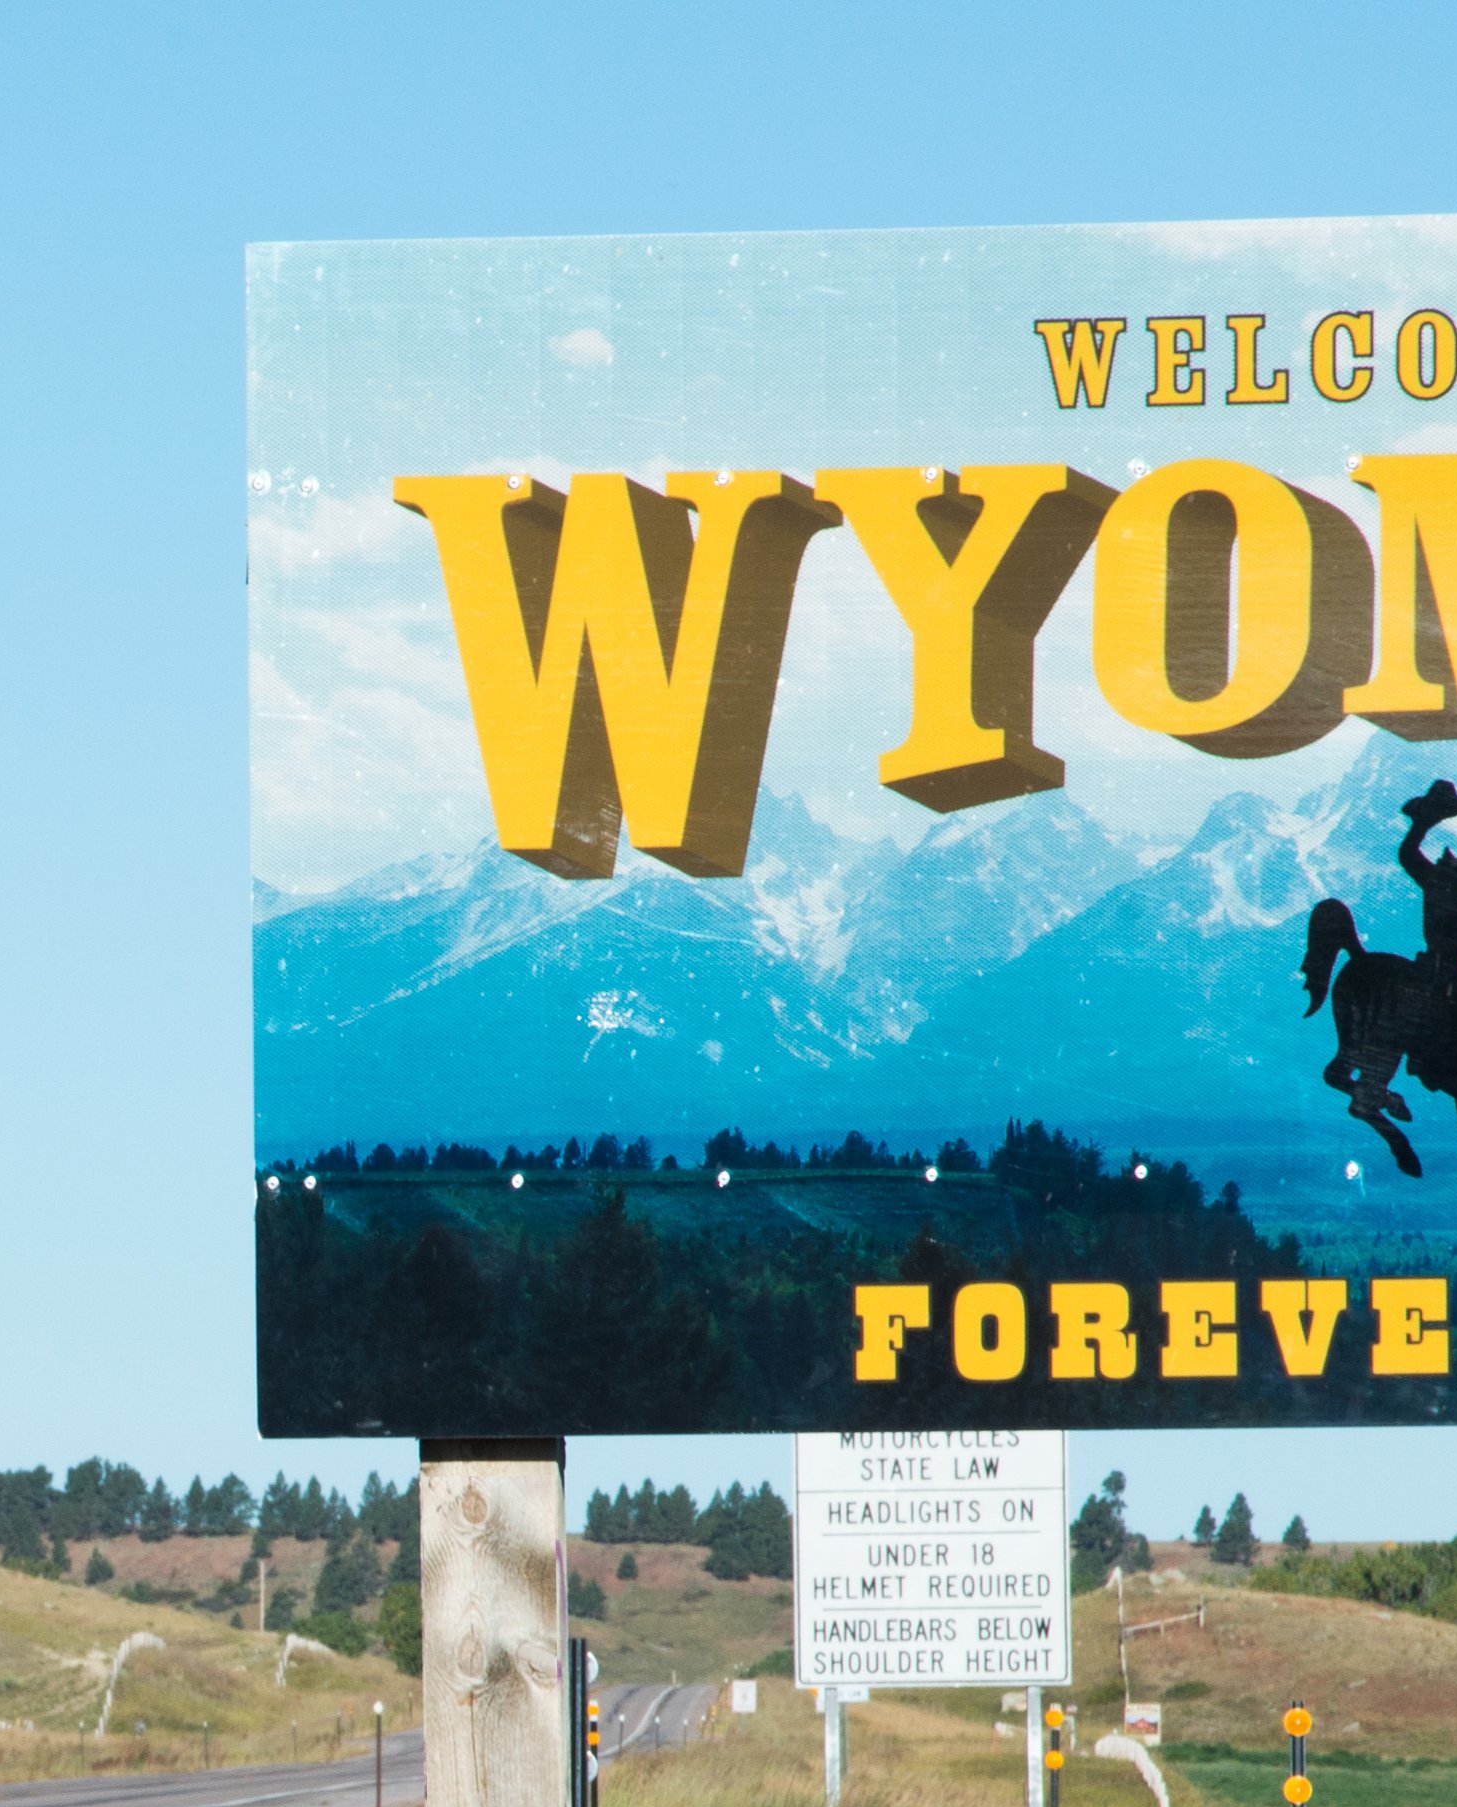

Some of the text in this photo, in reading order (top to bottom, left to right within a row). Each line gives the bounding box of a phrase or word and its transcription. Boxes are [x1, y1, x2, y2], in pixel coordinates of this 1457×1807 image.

[839, 1430, 1020, 1449] MOTORCYCLES
[861, 1456, 999, 1481] STATE LAW
[827, 1499, 1033, 1524] HEADLIGHTS ON
[868, 1543, 994, 1566] UNDER 18
[813, 1574, 1051, 1599] HELMET REQUIRED
[813, 1617, 1051, 1642] HANDLEBARS BELOW
[813, 1648, 1052, 1674] SHOULDER HEIGHT
